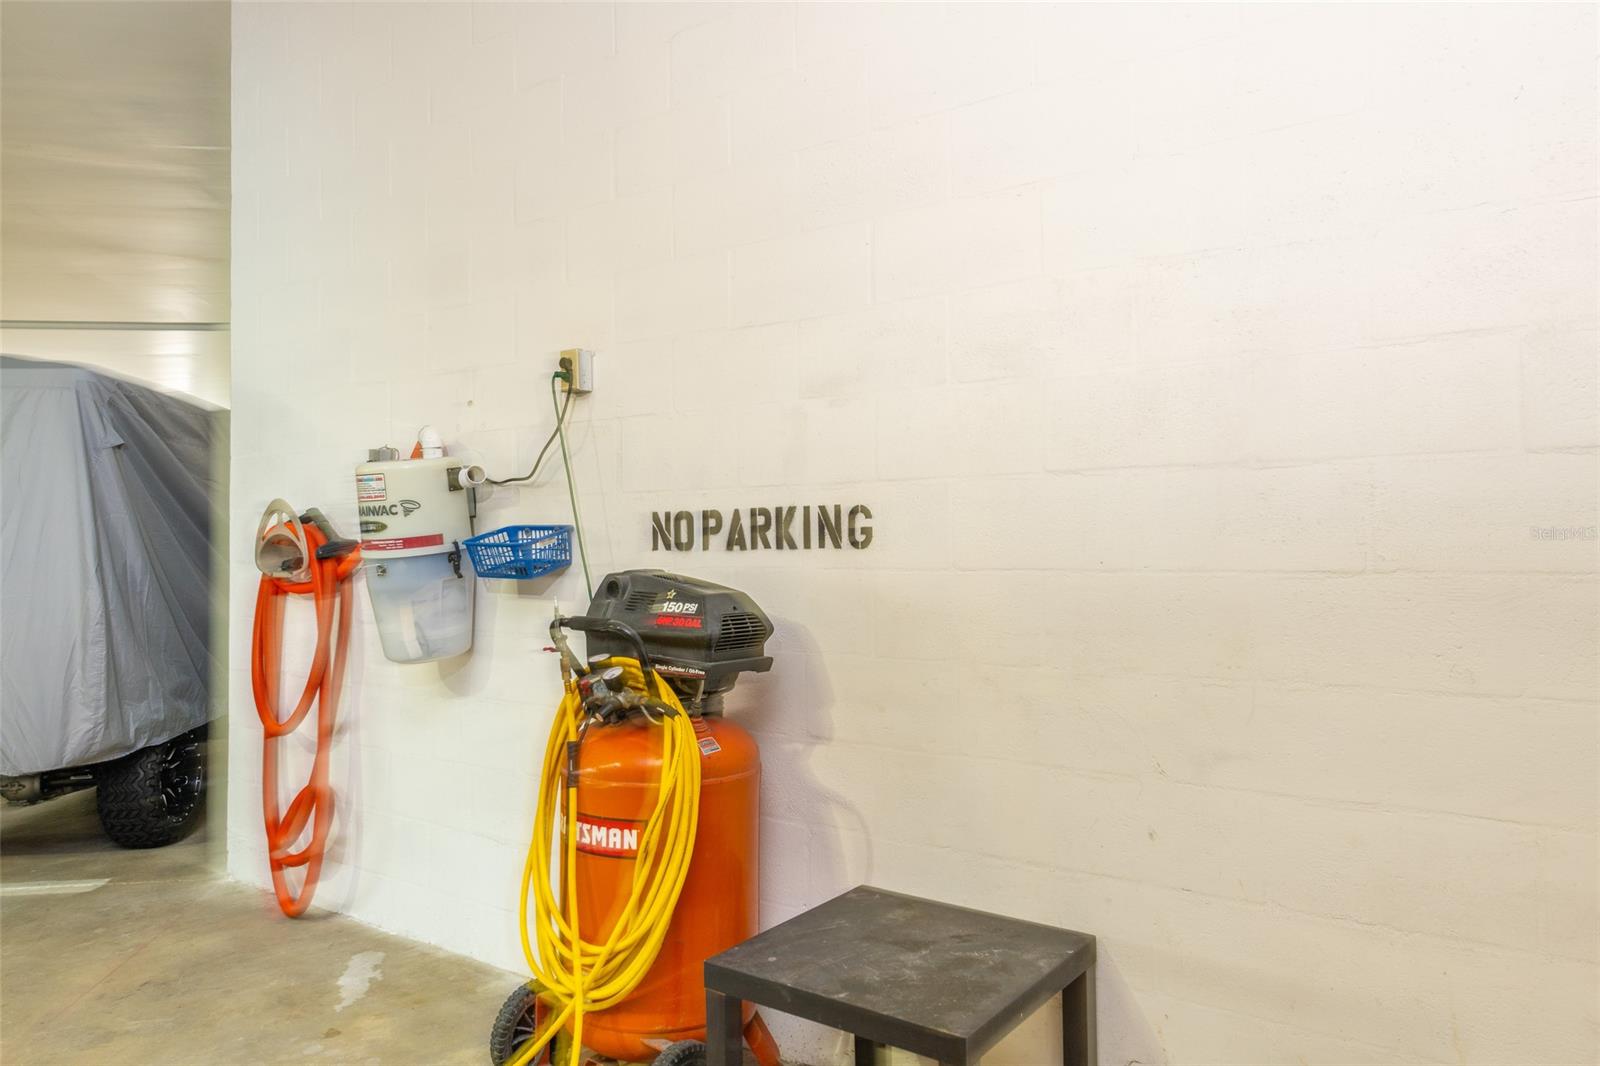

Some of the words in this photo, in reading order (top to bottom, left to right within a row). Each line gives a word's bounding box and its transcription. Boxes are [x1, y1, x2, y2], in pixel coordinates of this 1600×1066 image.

[652, 510, 694, 551] NO
[702, 504, 873, 552] PARKING
[662, 601, 683, 613] 150
[682, 603, 698, 614] PSI
